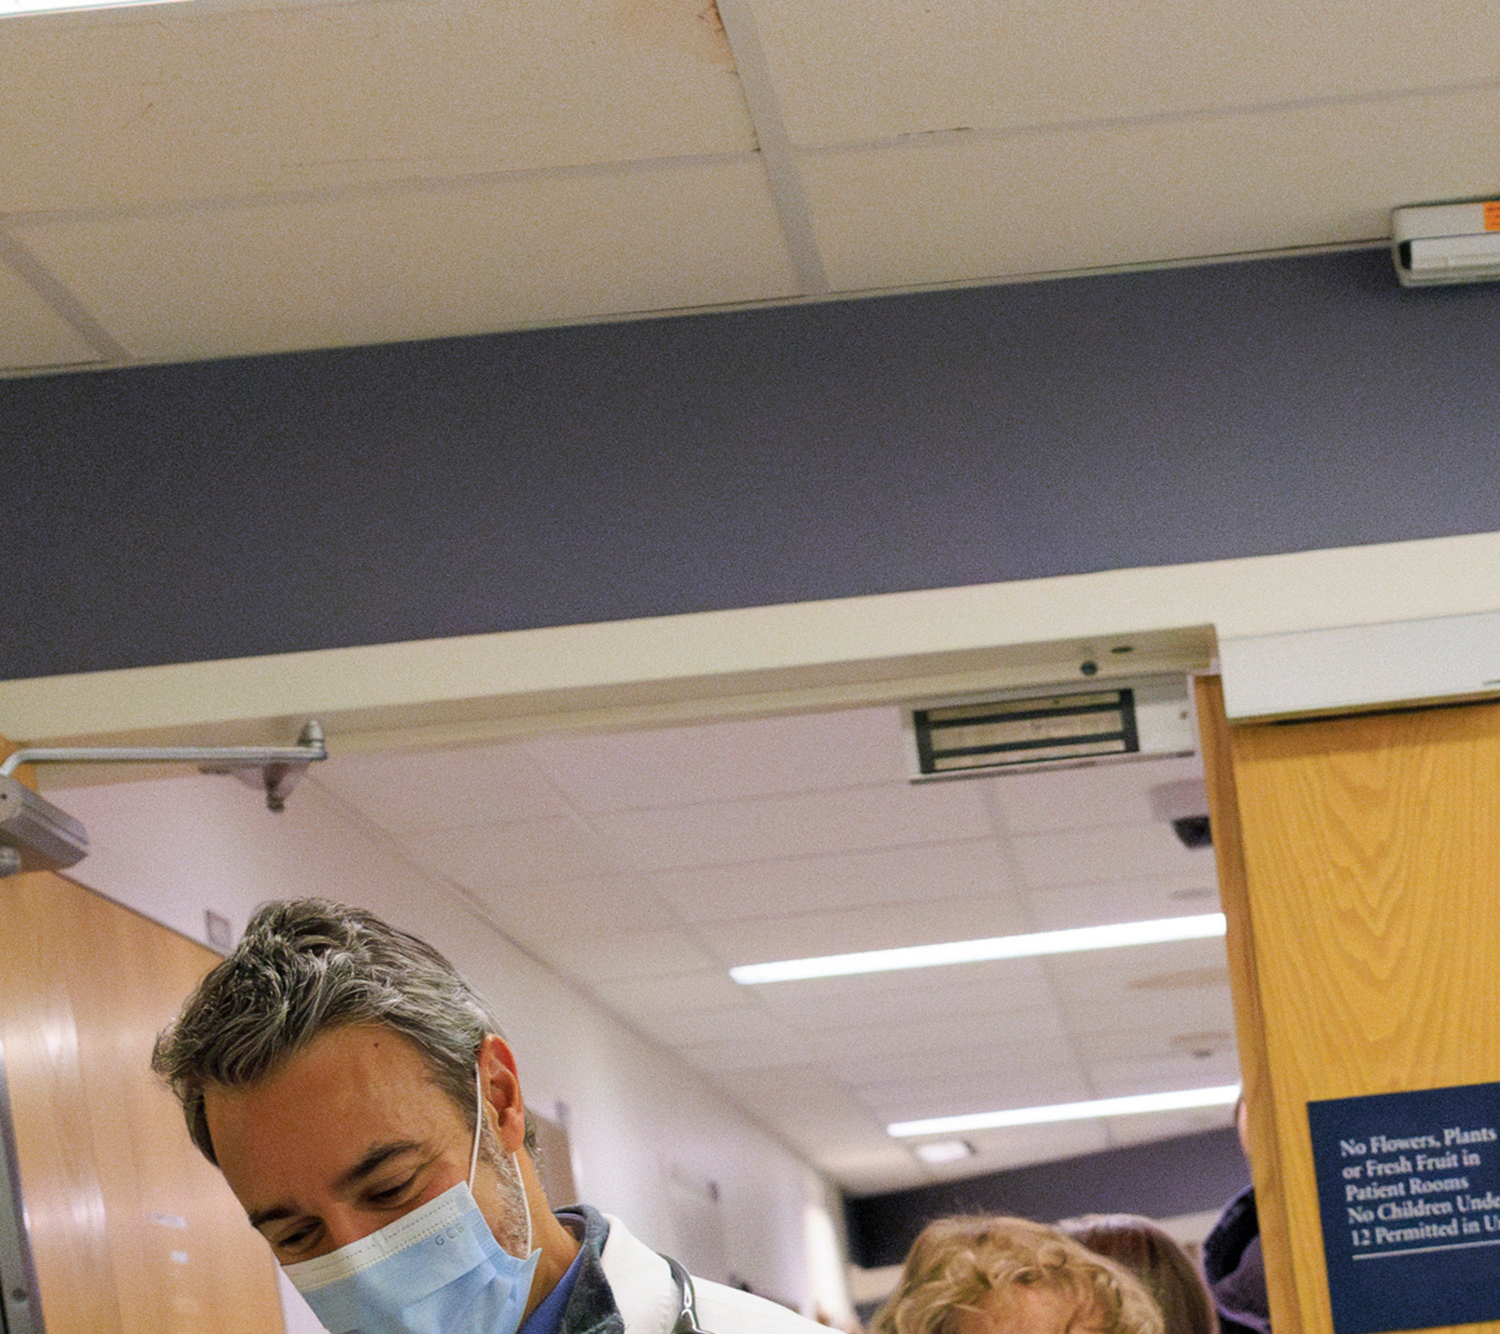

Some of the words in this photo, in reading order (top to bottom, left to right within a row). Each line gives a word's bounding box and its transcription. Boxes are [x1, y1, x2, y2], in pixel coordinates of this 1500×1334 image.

[1340, 1138, 1368, 1158] No
[1443, 1126, 1499, 1146] Plants
[1342, 1165, 1363, 1180] or
[1365, 1154, 1414, 1177] Fresh
[1415, 1150, 1460, 1172] Fruit
[1462, 1148, 1482, 1167] in
[1345, 1180, 1407, 1202] Patient
[1409, 1175, 1470, 1196] Rooms
[1347, 1205, 1376, 1225] No
[1376, 1197, 1454, 1222] Children
[1351, 1228, 1372, 1247] 12
[1374, 1217, 1459, 1245] Permitted
[1462, 1216, 1481, 1234] in
